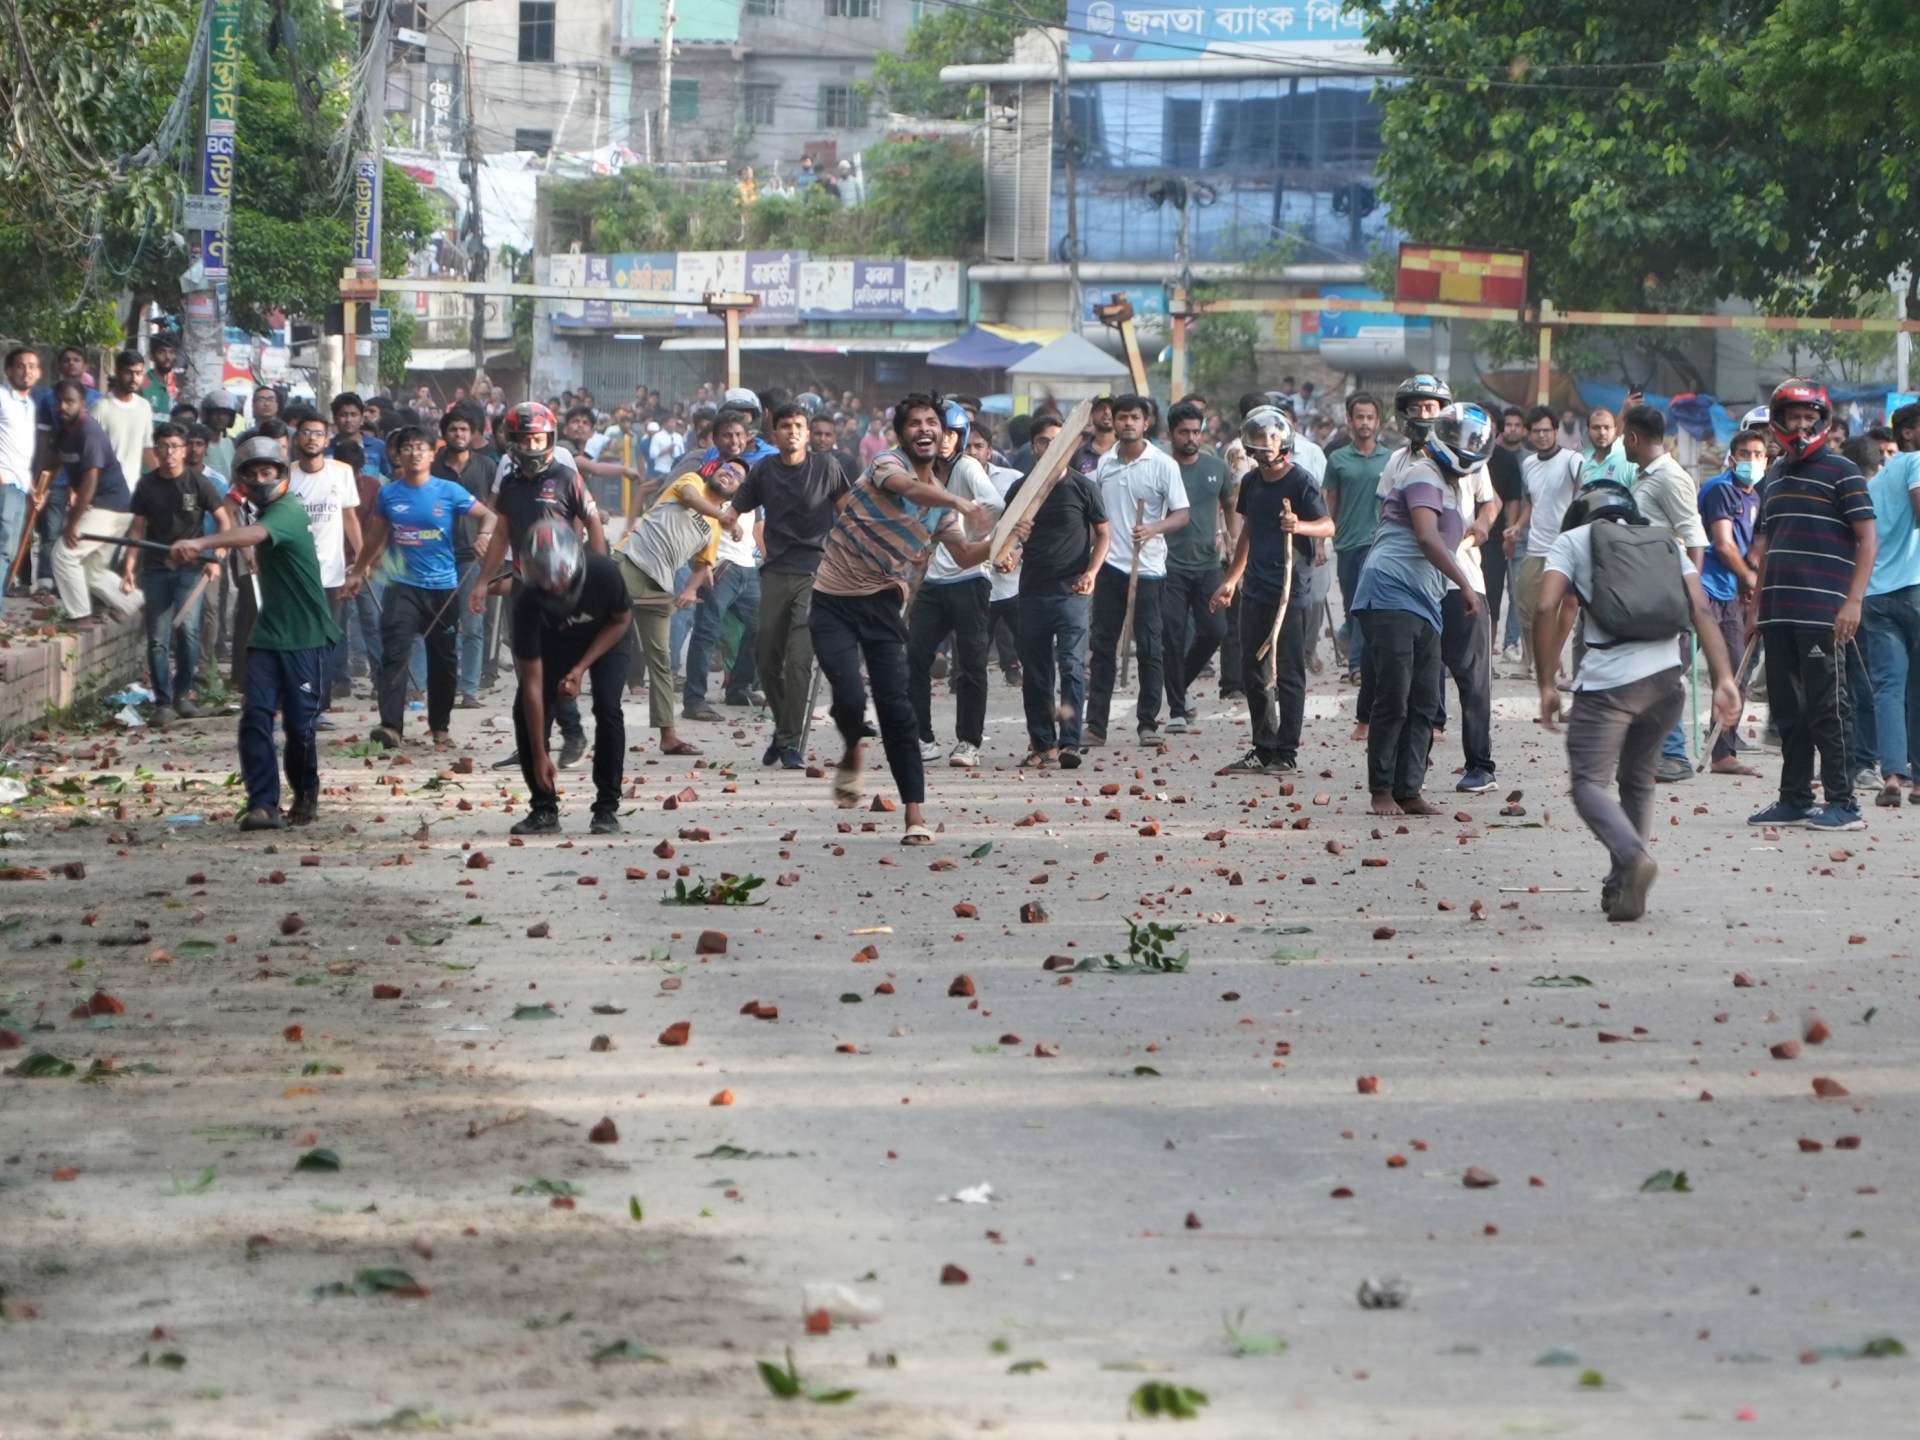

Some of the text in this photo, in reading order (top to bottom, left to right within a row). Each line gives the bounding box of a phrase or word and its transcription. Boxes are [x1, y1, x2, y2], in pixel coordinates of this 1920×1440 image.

[1122, 6, 1206, 36] জনতা
[1214, 5, 1295, 35] ব্যাংক
[301, 502, 337, 513] mirates
